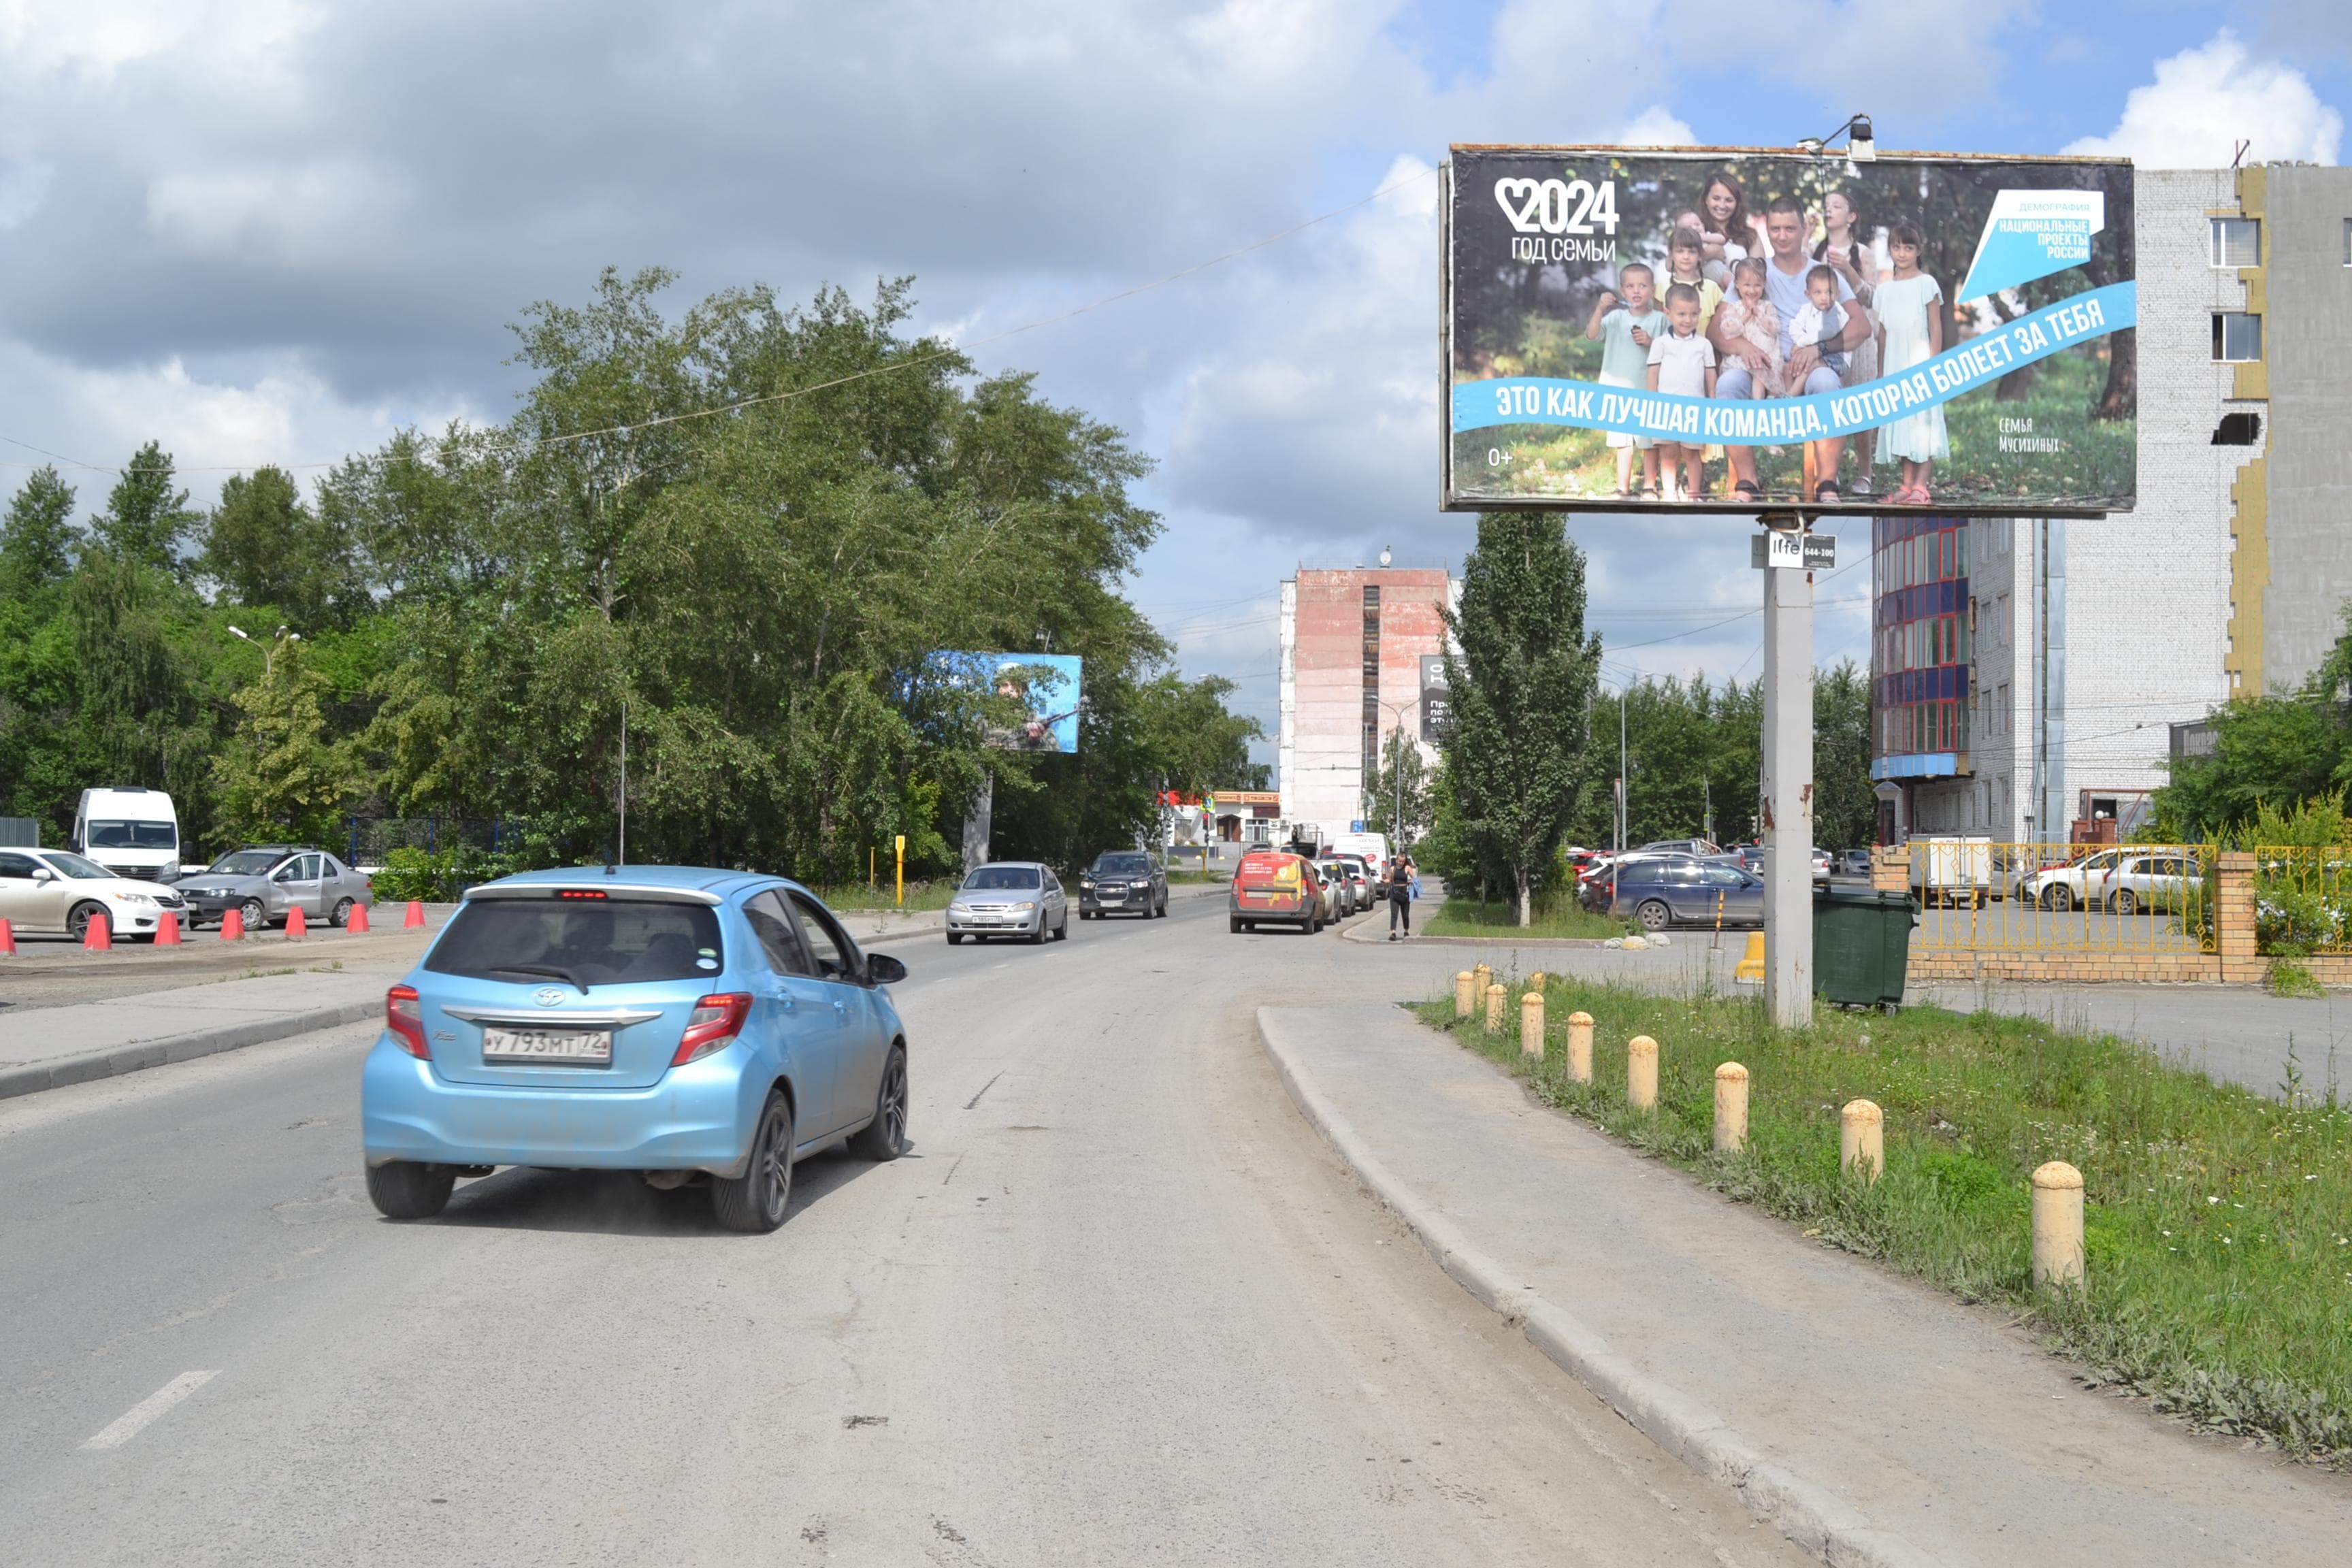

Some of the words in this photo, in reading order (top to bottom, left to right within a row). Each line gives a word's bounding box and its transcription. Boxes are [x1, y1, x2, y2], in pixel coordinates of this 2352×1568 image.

[1509, 178, 1620, 235] 2024
[2019, 201, 2091, 213] ДЕМОГРАФИЯ
[1999, 218, 2088, 234] НАЦИОНАЛЬНЫЕ
[2038, 233, 2089, 246] ПРОЕКТЫ
[1512, 237, 1548, 265] ГОД
[2047, 246, 2089, 259] РОССИИ
[1495, 386, 1540, 416] ЭТО
[1546, 387, 1594, 420] КАК
[1597, 393, 1698, 434] ЛУЧШАЯ
[1704, 404, 1829, 439] КОМАНДА,
[1830, 372, 1932, 428] КОТОРАЯ
[1931, 334, 2014, 393] БОЛЕЕТ
[2014, 321, 2048, 355] ЗА
[2046, 298, 2105, 342] ТЕБЯ
[1488, 448, 1514, 467] 0+
[1804, 547, 1835, 557] 644-100
[583, 1032, 602, 1049] 72
